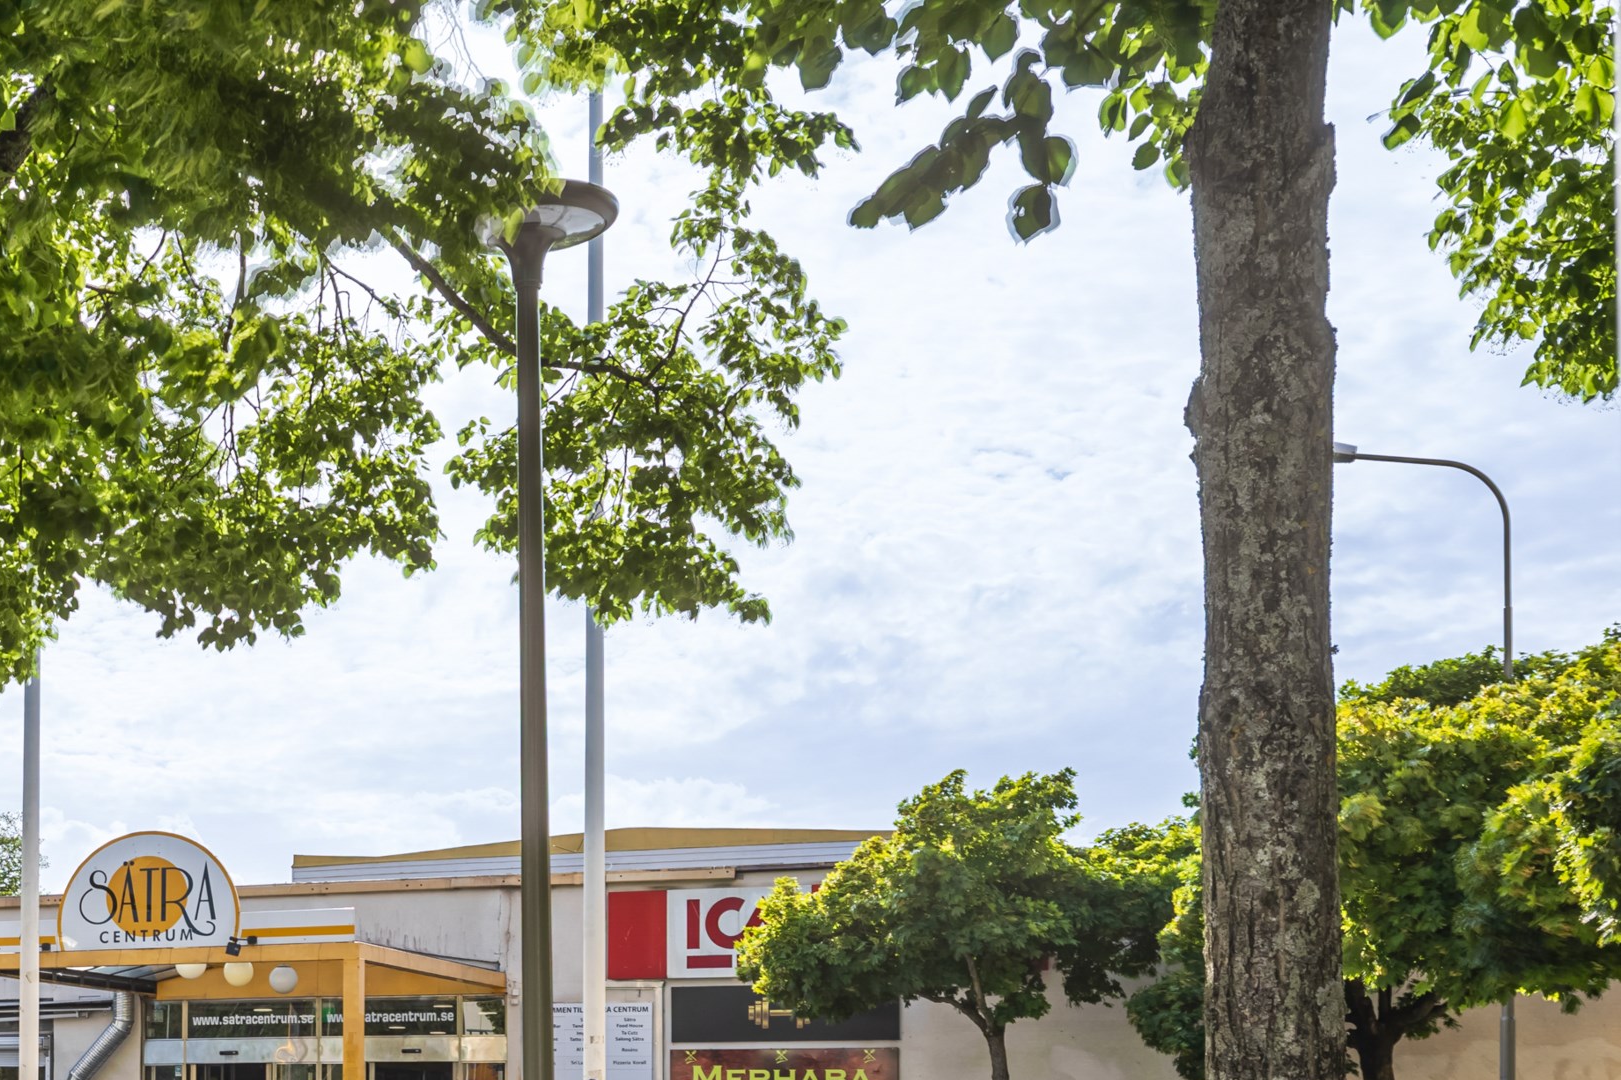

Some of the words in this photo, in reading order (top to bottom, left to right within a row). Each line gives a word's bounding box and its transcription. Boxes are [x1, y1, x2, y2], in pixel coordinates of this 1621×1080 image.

[79, 861, 216, 936] SÄTRA
[687, 897, 766, 949] IC
[99, 928, 193, 944] CENTRUM
[192, 1013, 314, 1026] www.satracentrum.se
[326, 1011, 454, 1023] wwatracentrum.se
